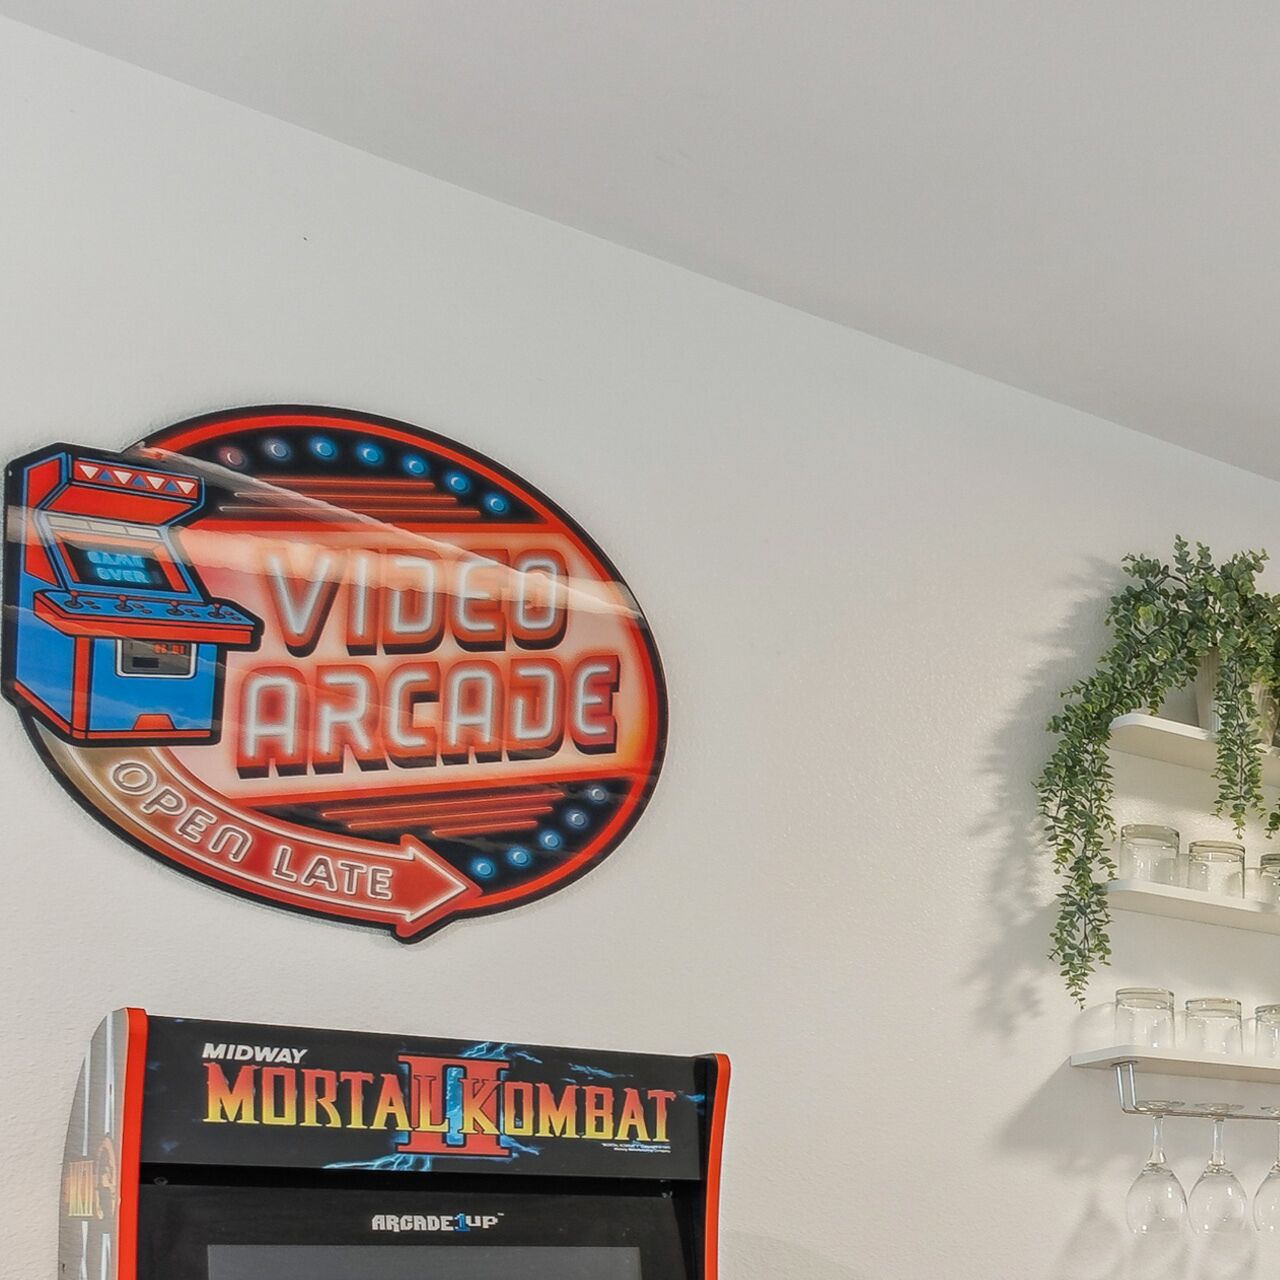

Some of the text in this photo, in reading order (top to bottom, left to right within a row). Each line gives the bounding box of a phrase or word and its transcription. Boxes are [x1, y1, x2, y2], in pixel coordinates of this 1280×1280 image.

[264, 548, 568, 657] VIDEO
[236, 655, 621, 779] ARCADE
[110, 760, 393, 899] OPEN LATE
[201, 1043, 307, 1064] MIDWAY
[203, 1063, 449, 1132] MORTAL
[460, 1077, 676, 1142] KOMBAT
[372, 1212, 498, 1232] ARCADE1UP
